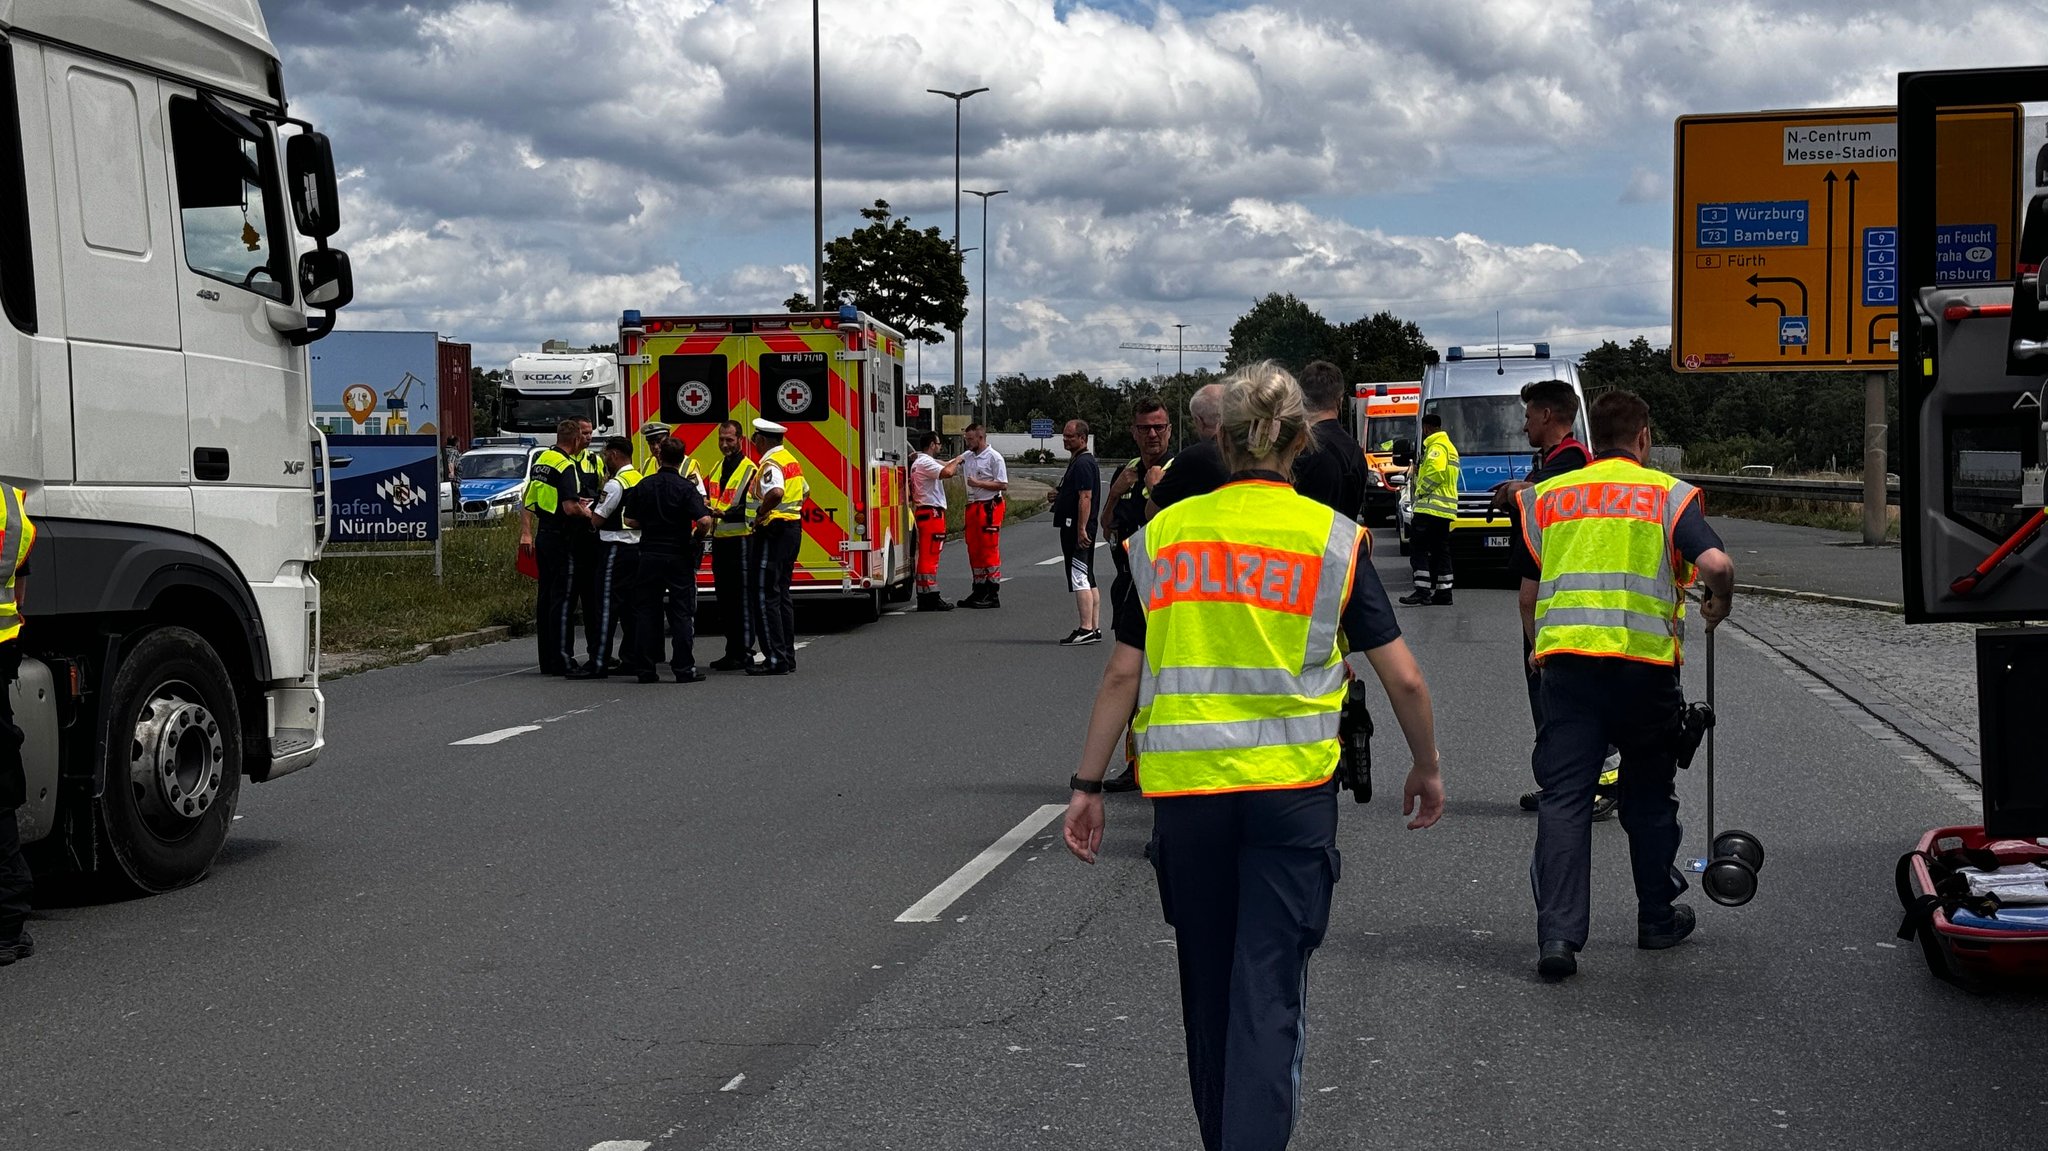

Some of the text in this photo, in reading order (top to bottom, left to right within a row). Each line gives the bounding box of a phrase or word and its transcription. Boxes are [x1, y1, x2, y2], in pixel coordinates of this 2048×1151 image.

[1787, 130, 1872, 143] N.-Centrum
[1787, 146, 1897, 161] Messe-Stadion
[1711, 205, 1805, 222] 3 Würzburg
[1708, 228, 1799, 243] 73 Bamberg
[1878, 234, 1885, 244] 9
[1954, 230, 1991, 243] Feucht
[1705, 254, 1766, 267] 8 Fürth
[1878, 252, 1885, 262] 6
[1936, 249, 1986, 262] raha CZ
[1878, 270, 1885, 280] 3
[1936, 268, 1991, 281] nsburg
[1878, 287, 1885, 298] 6
[283, 460, 305, 475] XF
[1474, 465, 1532, 474] POLIZE
[1543, 484, 1663, 521] POLIZEI
[340, 517, 427, 538] Nürnberg
[1152, 551, 1304, 605] POLIZEI
